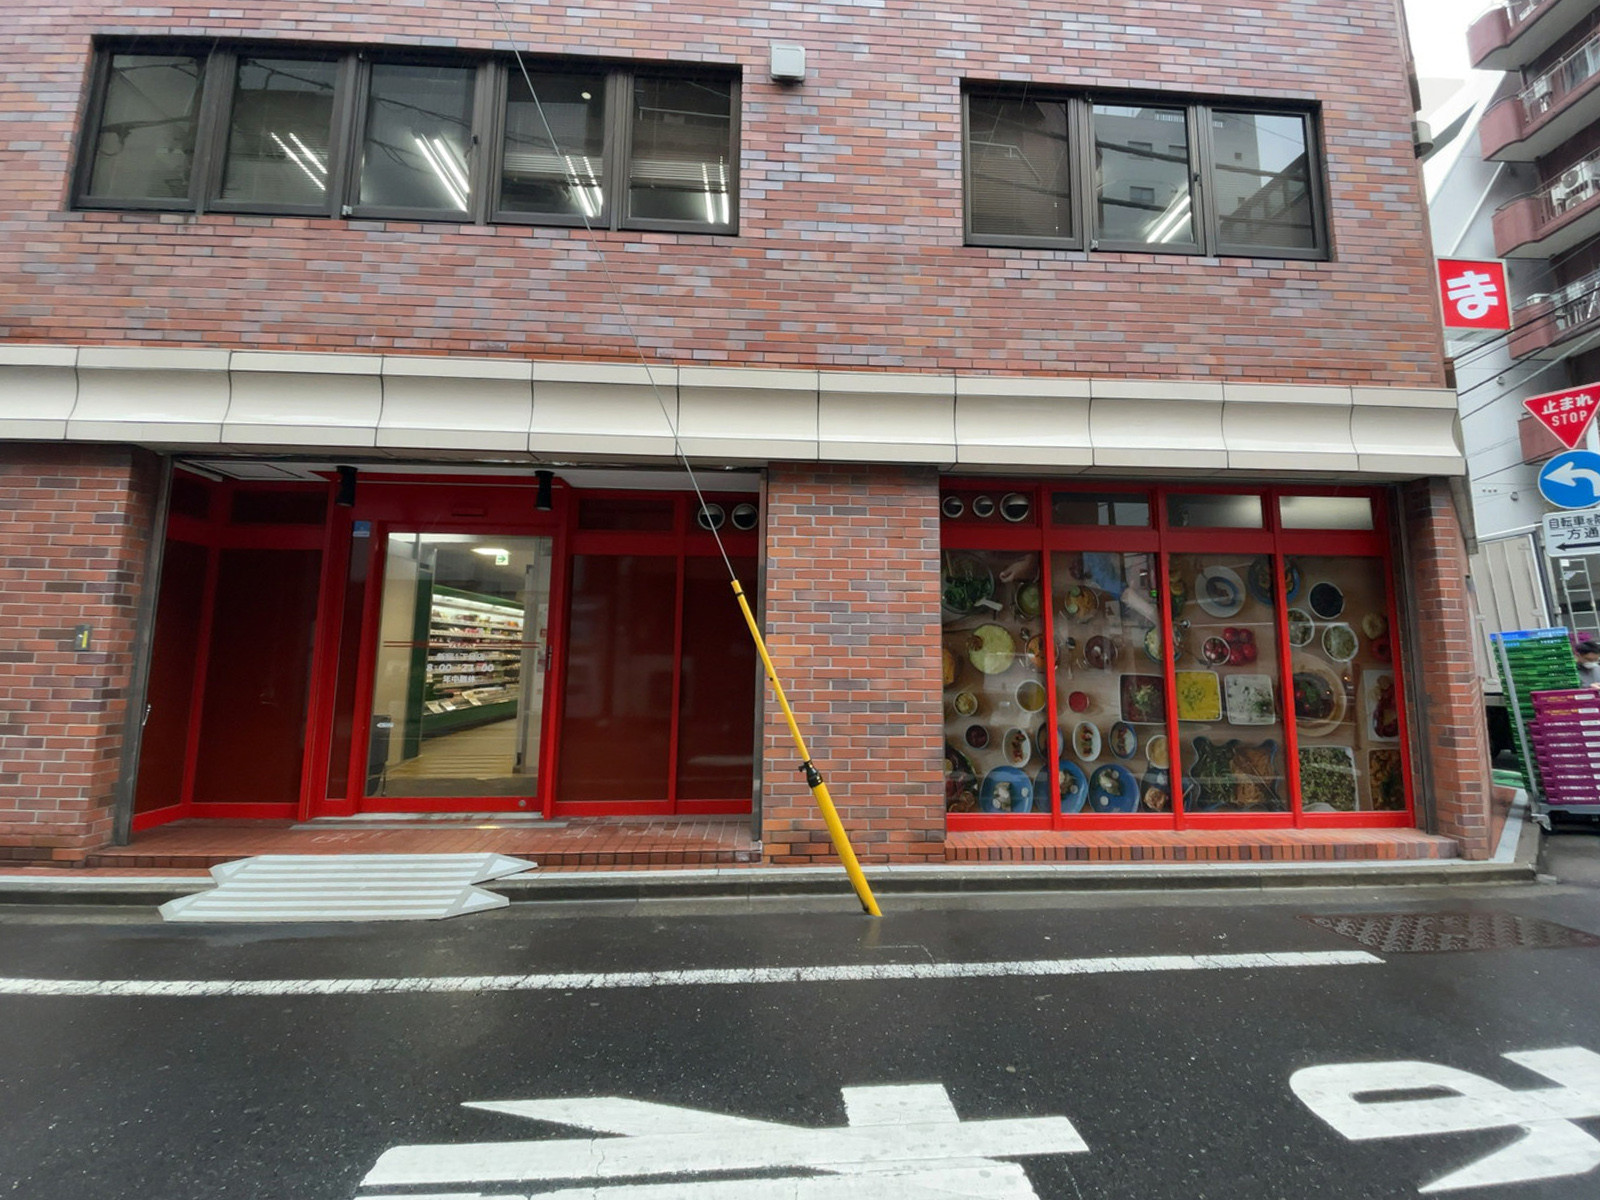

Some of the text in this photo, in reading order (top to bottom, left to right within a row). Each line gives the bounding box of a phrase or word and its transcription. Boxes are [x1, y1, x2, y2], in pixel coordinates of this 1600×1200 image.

[1446, 270, 1499, 320] ま
[1541, 393, 1594, 415] 止まれ
[1551, 410, 1587, 427] STOP
